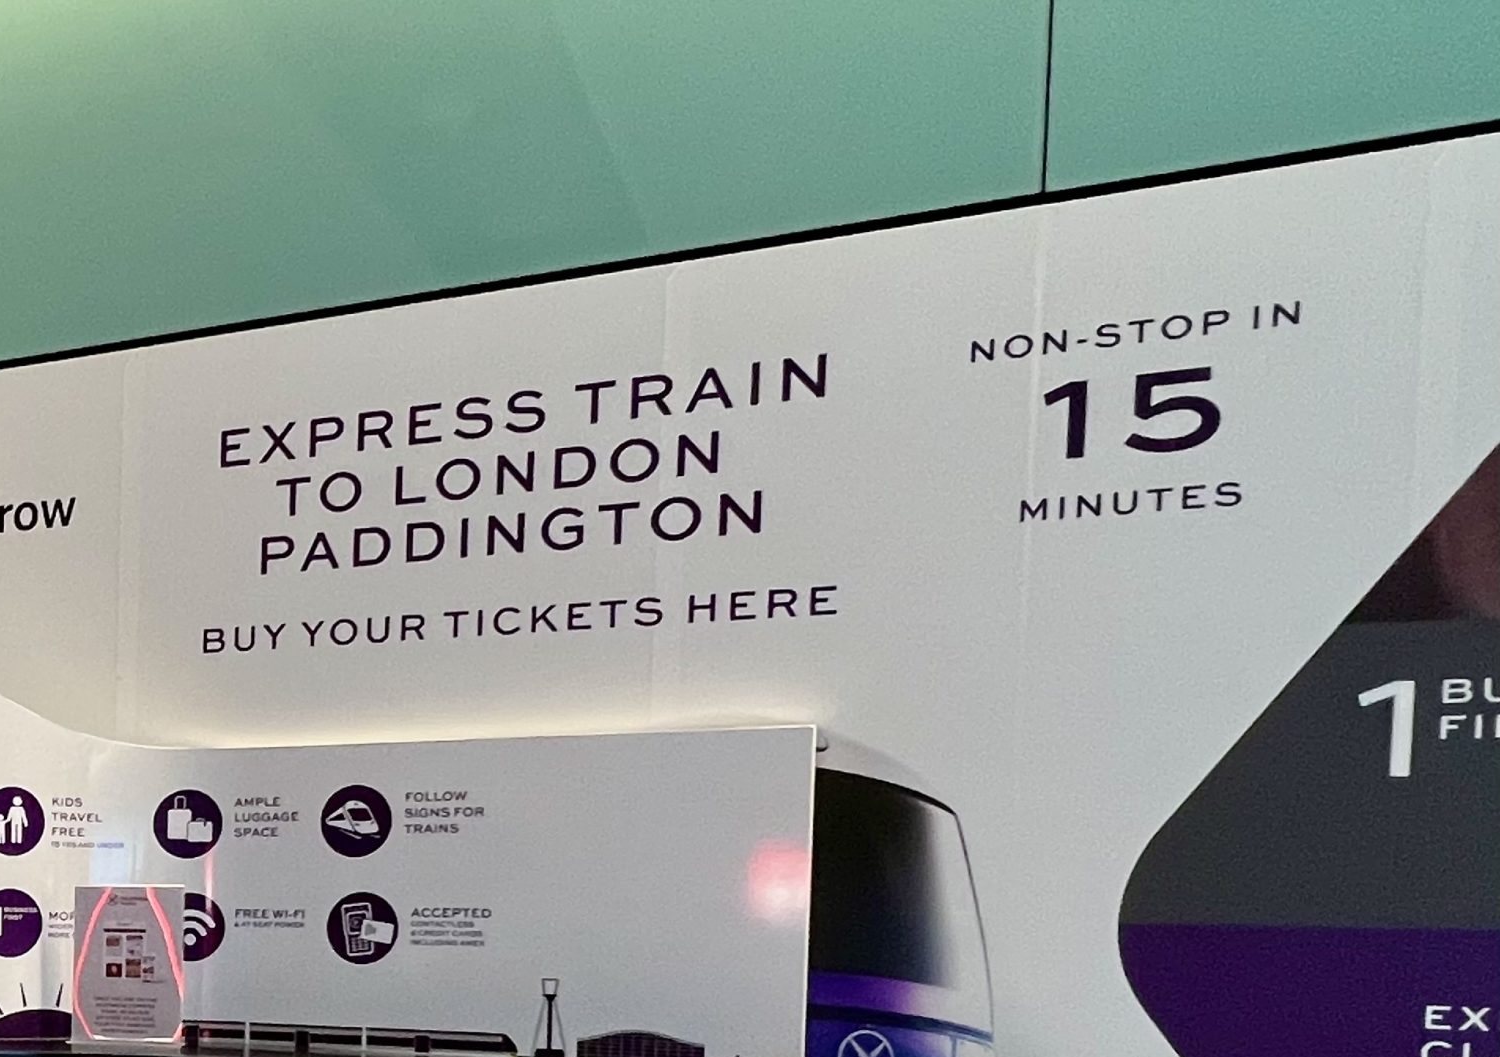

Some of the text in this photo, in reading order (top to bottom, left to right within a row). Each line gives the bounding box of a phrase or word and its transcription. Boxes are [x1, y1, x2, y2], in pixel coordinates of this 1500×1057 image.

[970, 301, 1301, 363] NON-STOP IN
[219, 353, 828, 468] EXPRESS TRAIN
[1044, 366, 1221, 459] 15
[276, 430, 720, 517] TO LONDON
[1019, 482, 1243, 522] MINUTES
[260, 490, 763, 575] PADDINGTON
[203, 585, 838, 654] BUY YOUR TICKETS HERE
[1358, 680, 1415, 777] 1
[235, 797, 280, 807] AMPLE
[405, 791, 467, 802] FOLLOW
[52, 798, 83, 807] KIDS
[52, 813, 102, 822] TRAVEL
[235, 812, 299, 822] LUGGAGE
[405, 807, 484, 818] SIGNS FOR
[51, 828, 85, 837] FREE
[234, 827, 278, 837] SPACE
[405, 824, 459, 834] TRAINS
[235, 909, 305, 919] FREE WI-FI
[411, 908, 492, 918] ACCEPTED
